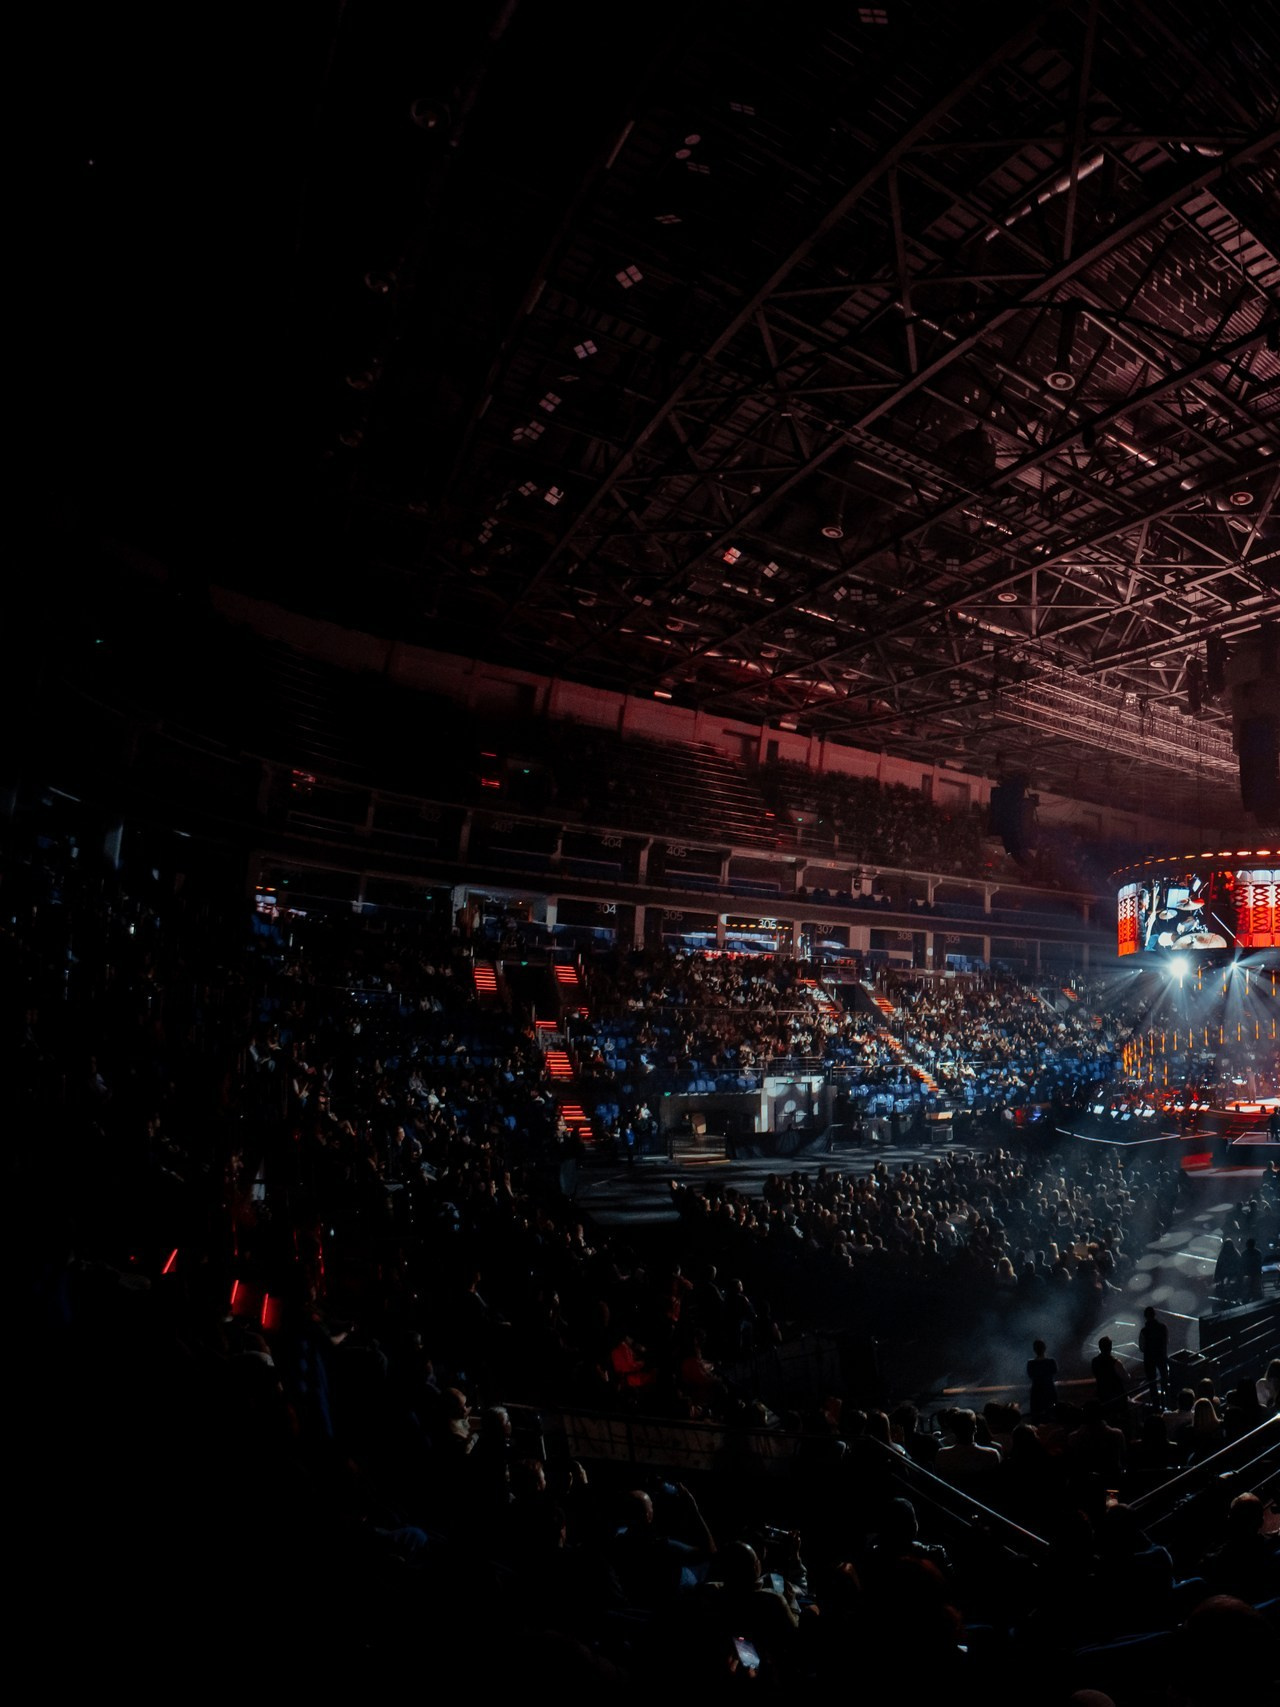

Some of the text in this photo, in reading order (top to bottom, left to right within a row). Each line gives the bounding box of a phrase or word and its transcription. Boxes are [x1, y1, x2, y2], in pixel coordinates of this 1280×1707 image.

[600, 837, 622, 849] 404
[664, 846, 687, 858] 405
[595, 903, 617, 915] 304
[663, 910, 684, 922] 305
[757, 919, 777, 931] 306
[816, 924, 835, 935] 307
[945, 934, 961, 944] 309
